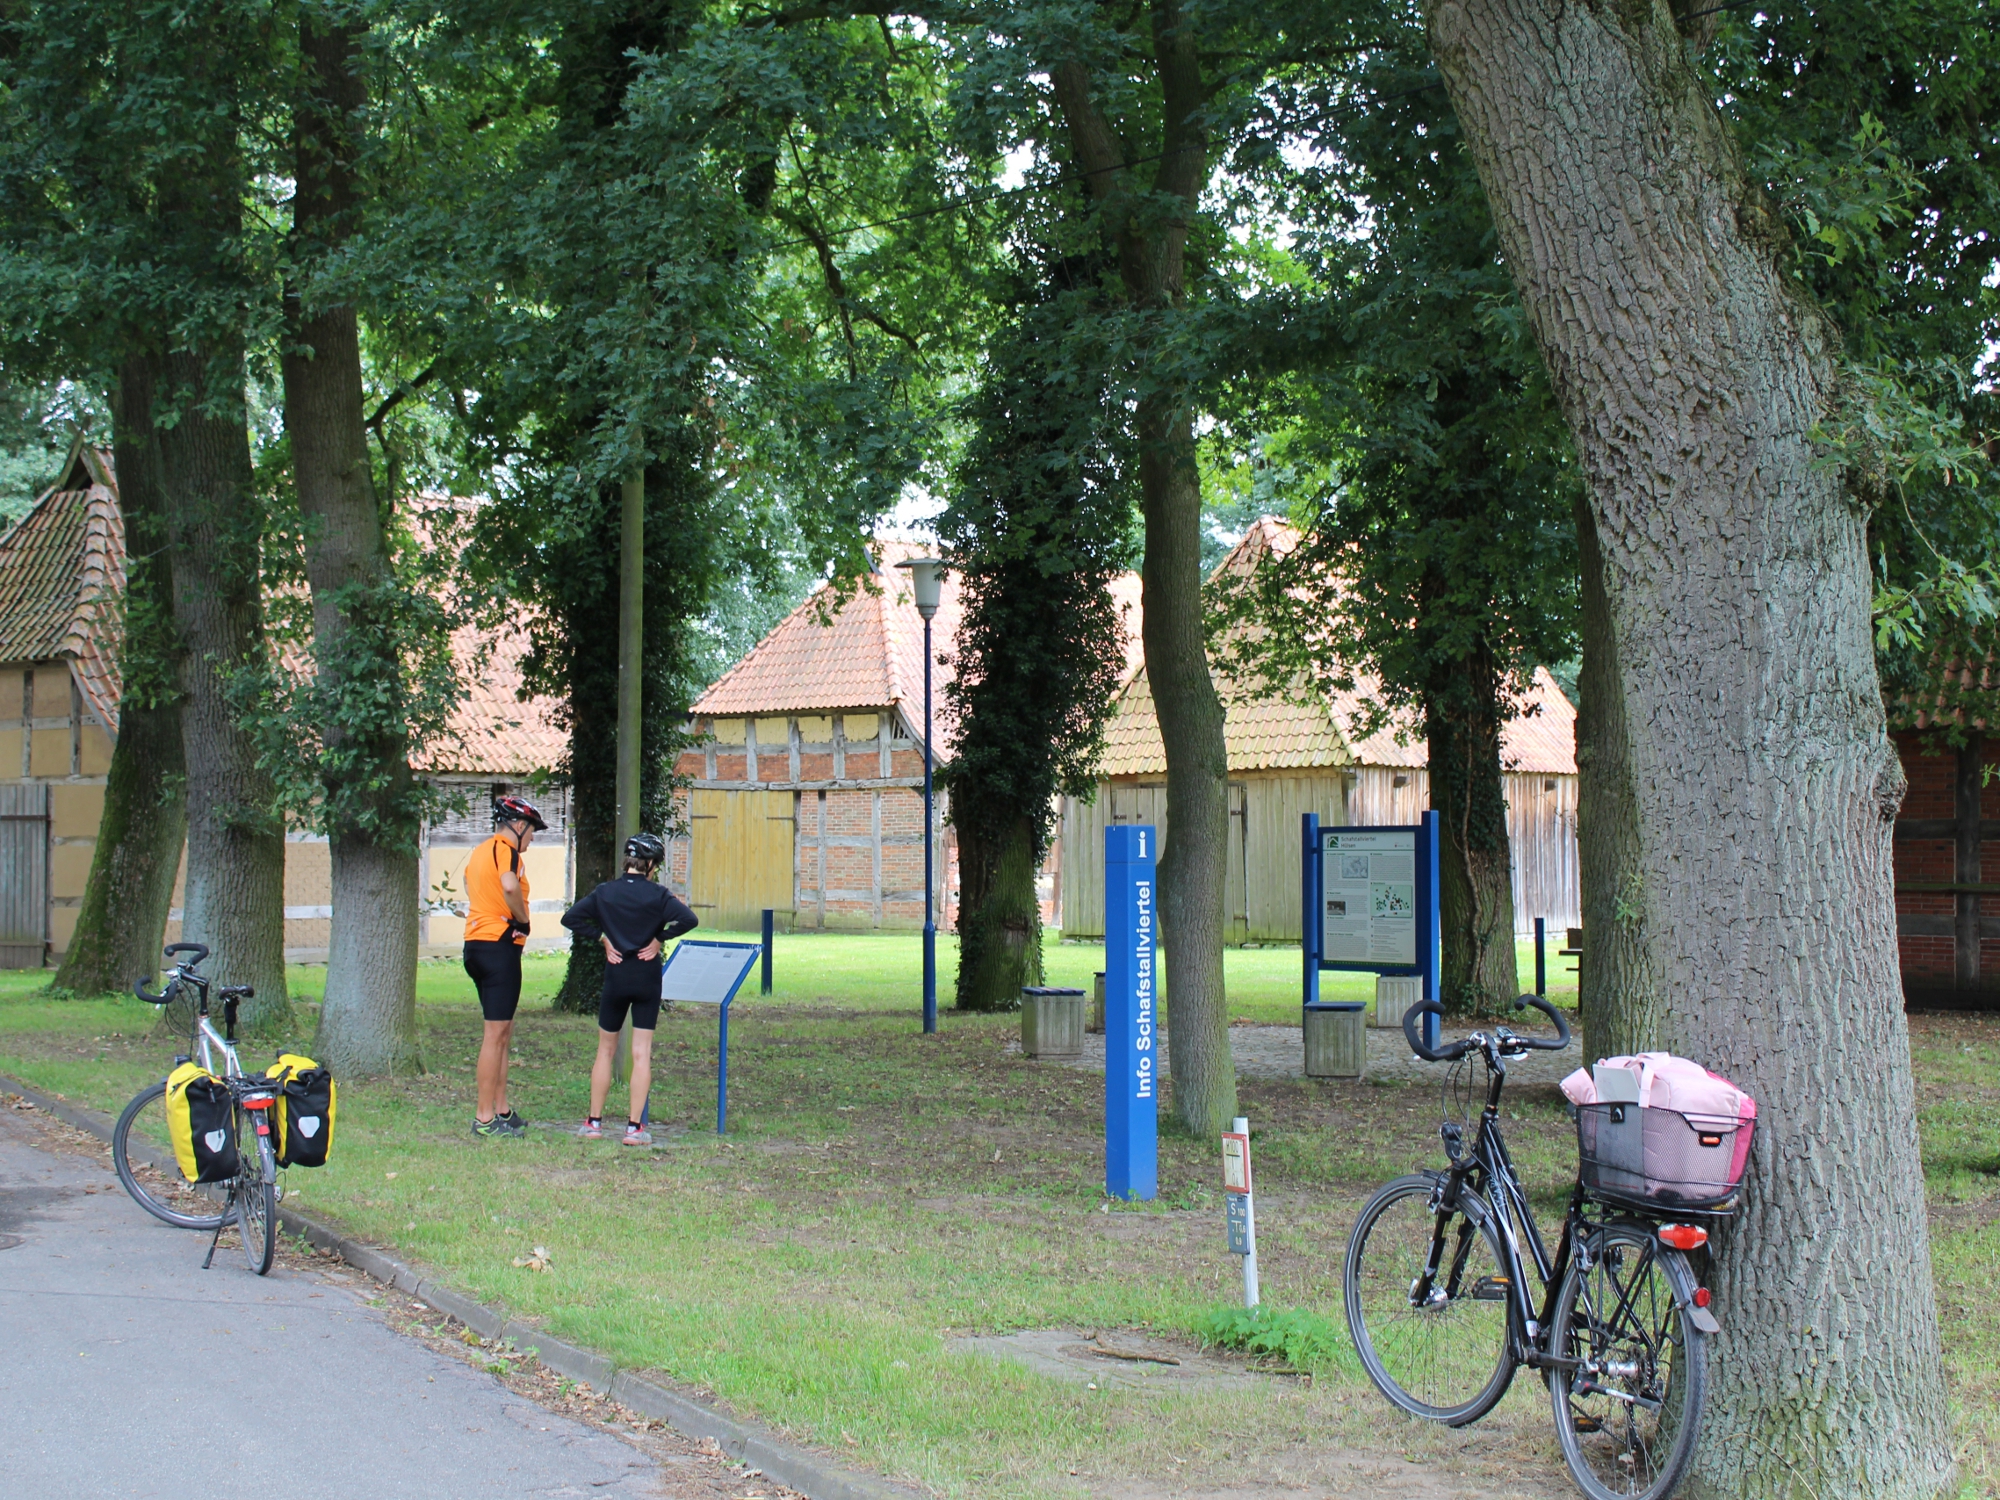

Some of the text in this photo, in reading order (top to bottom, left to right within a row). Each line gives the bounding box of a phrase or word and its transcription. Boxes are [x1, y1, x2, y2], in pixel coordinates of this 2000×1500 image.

[1138, 831, 1148, 858] i
[1136, 881, 1151, 1098] Info Schafstallviertel
[1230, 1202, 1246, 1217] S 100
